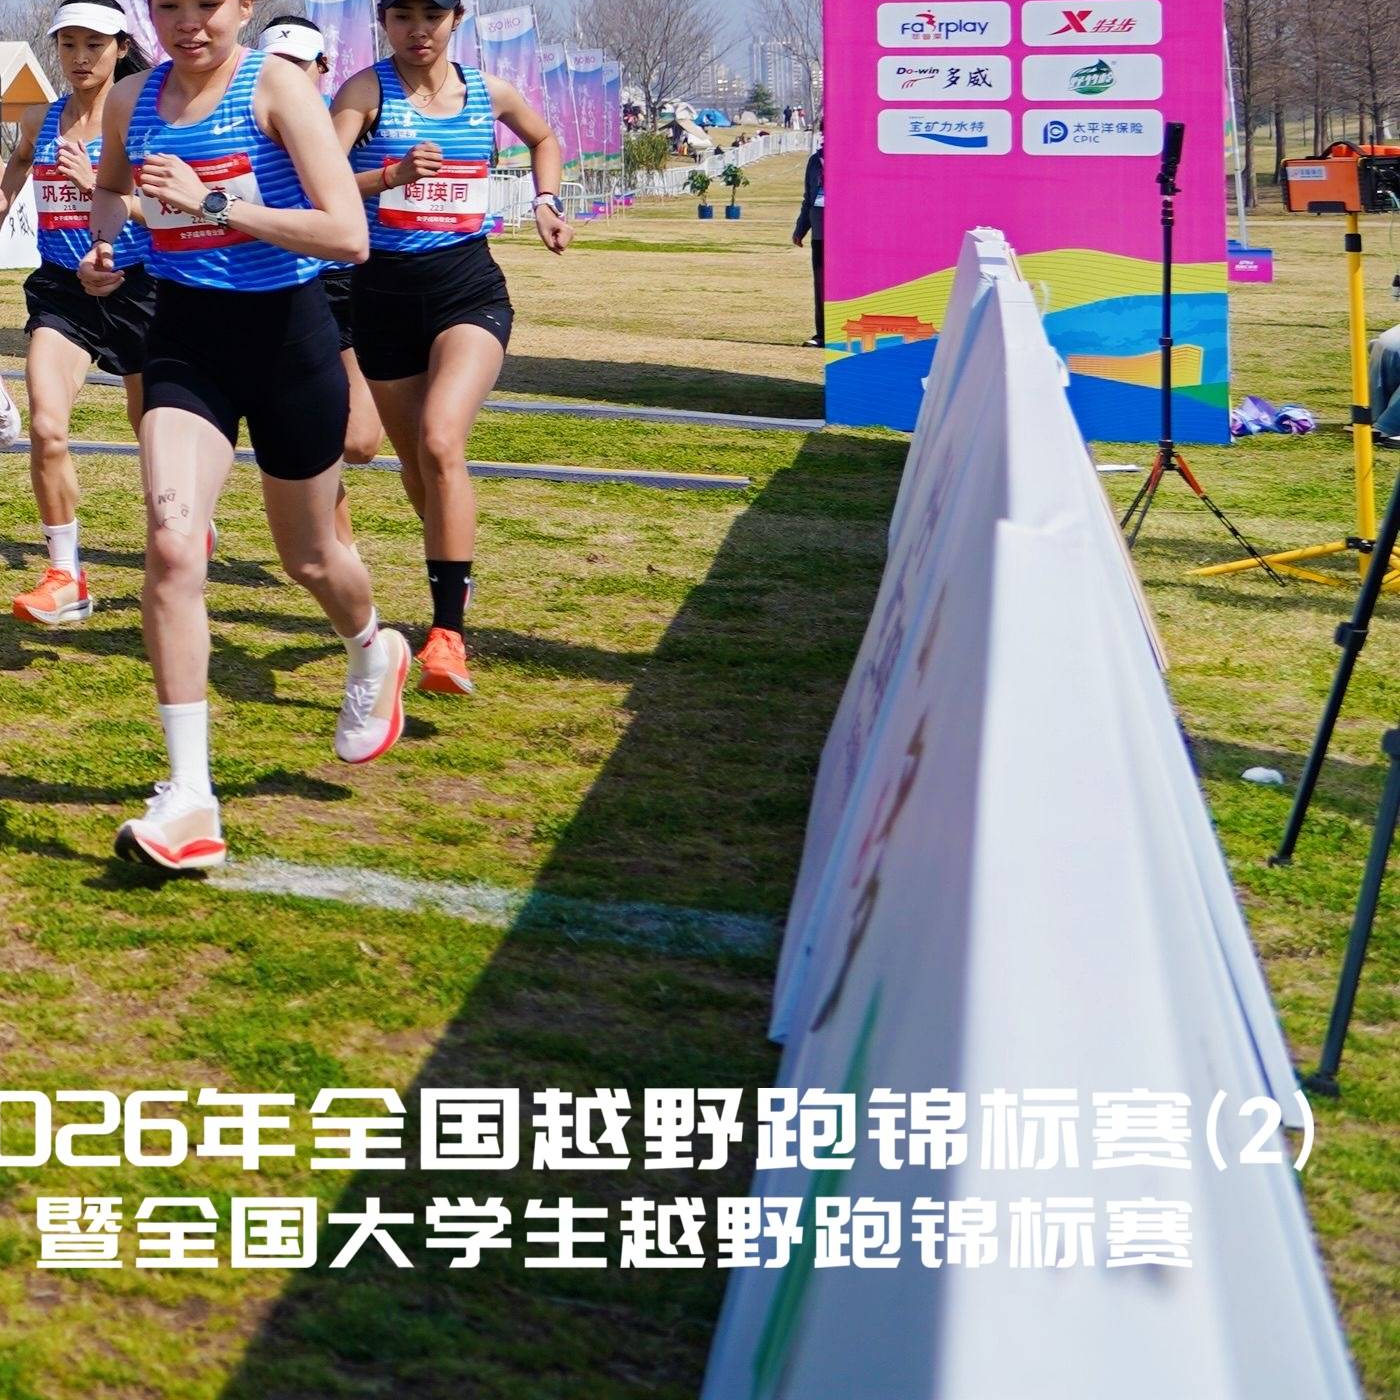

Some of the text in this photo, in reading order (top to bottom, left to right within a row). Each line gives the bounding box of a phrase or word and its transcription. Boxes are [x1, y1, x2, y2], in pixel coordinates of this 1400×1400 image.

[896, 66, 940, 75] Do-win
[943, 67, 993, 90] 多威
[908, 120, 985, 133] 宝矿力水特
[1073, 122, 1144, 134] 太平洋保险
[1073, 135, 1100, 144] CPIC
